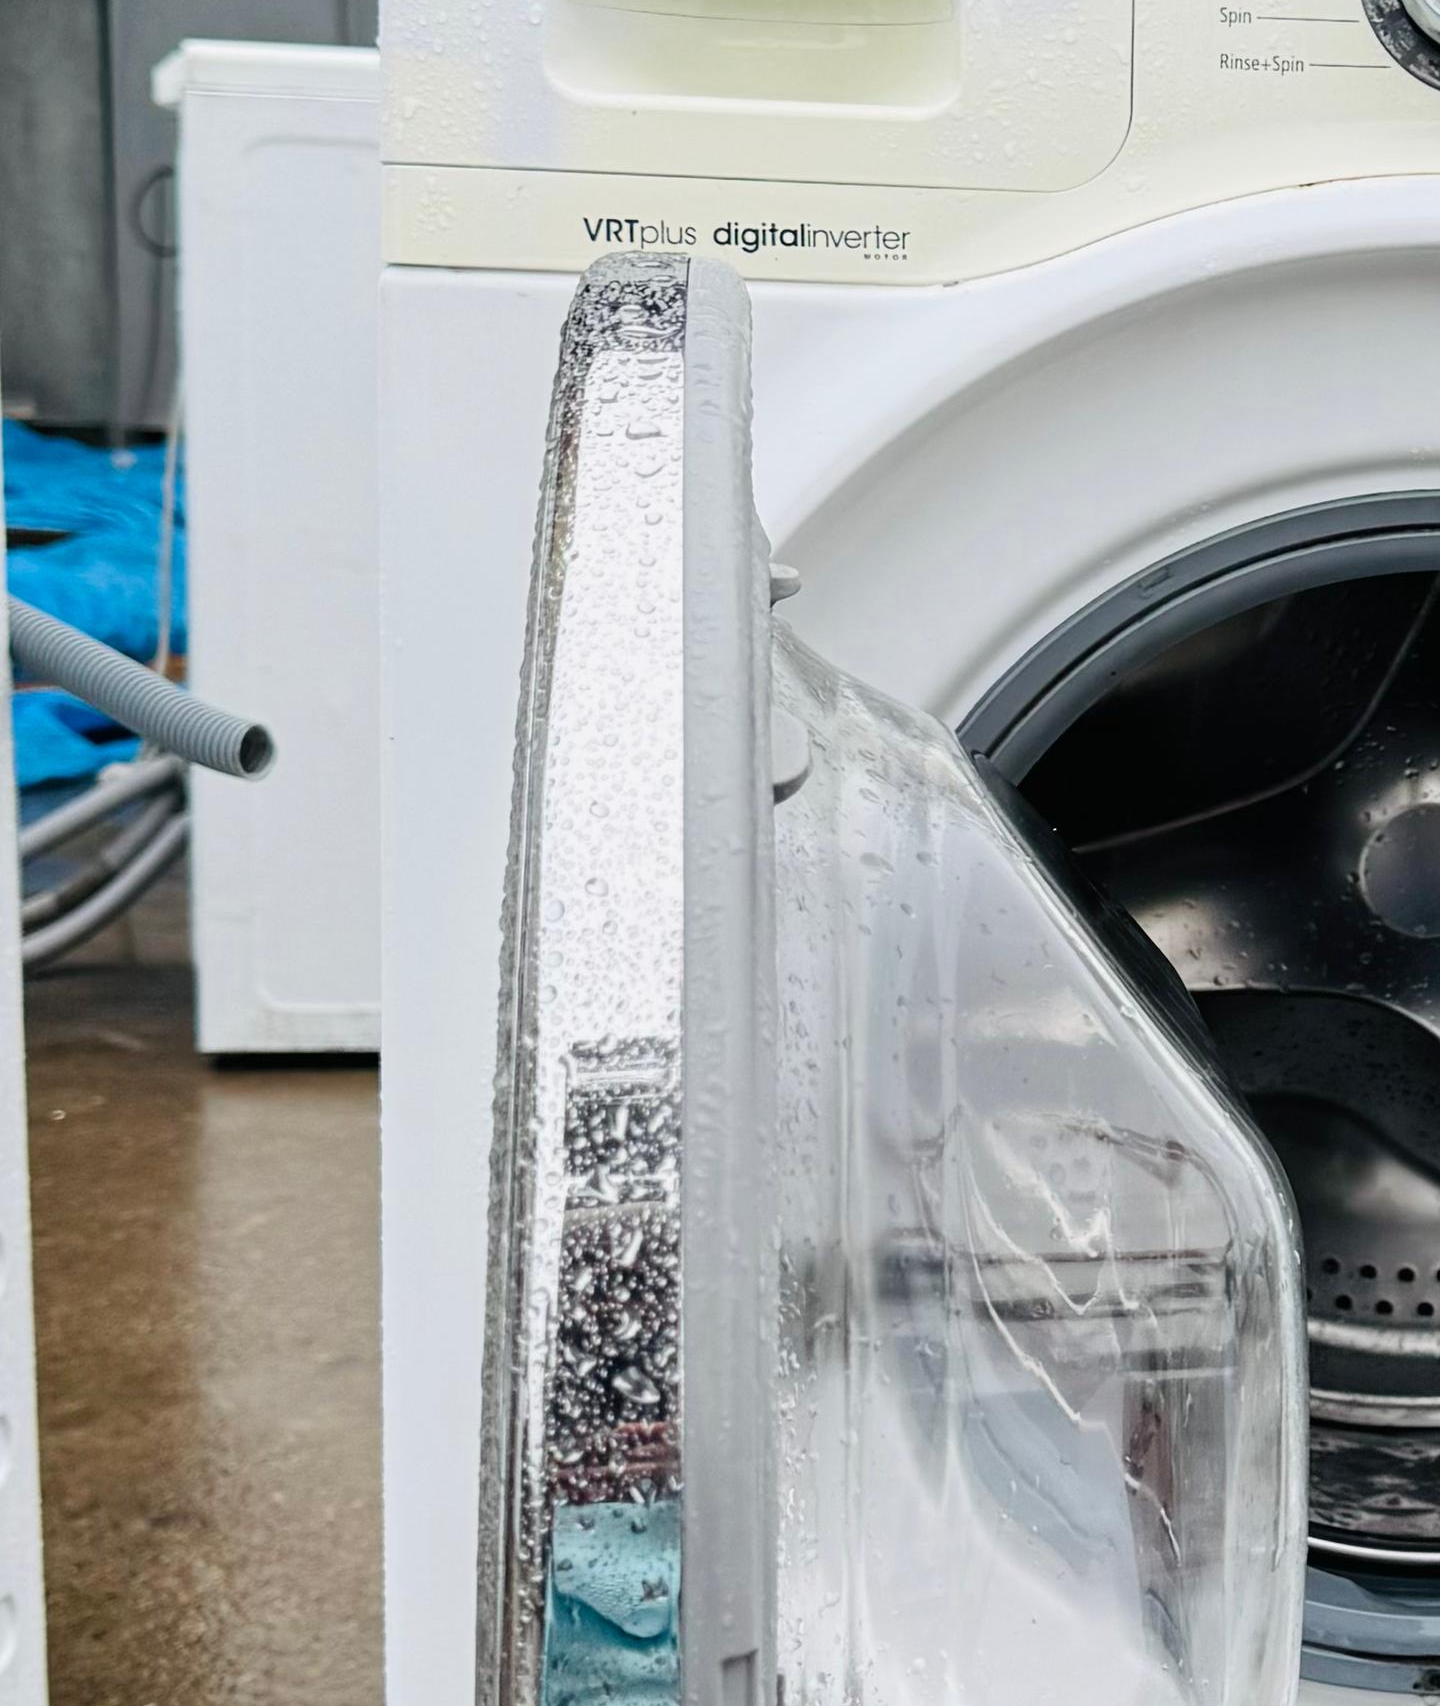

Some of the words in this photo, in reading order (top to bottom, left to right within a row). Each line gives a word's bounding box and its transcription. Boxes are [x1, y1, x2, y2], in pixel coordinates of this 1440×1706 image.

[1220, 7, 1252, 28] Spin
[1220, 53, 1304, 77] Rinse+Spin
[582, 217, 697, 251] VRTplus
[713, 221, 911, 255] digitalinverter
